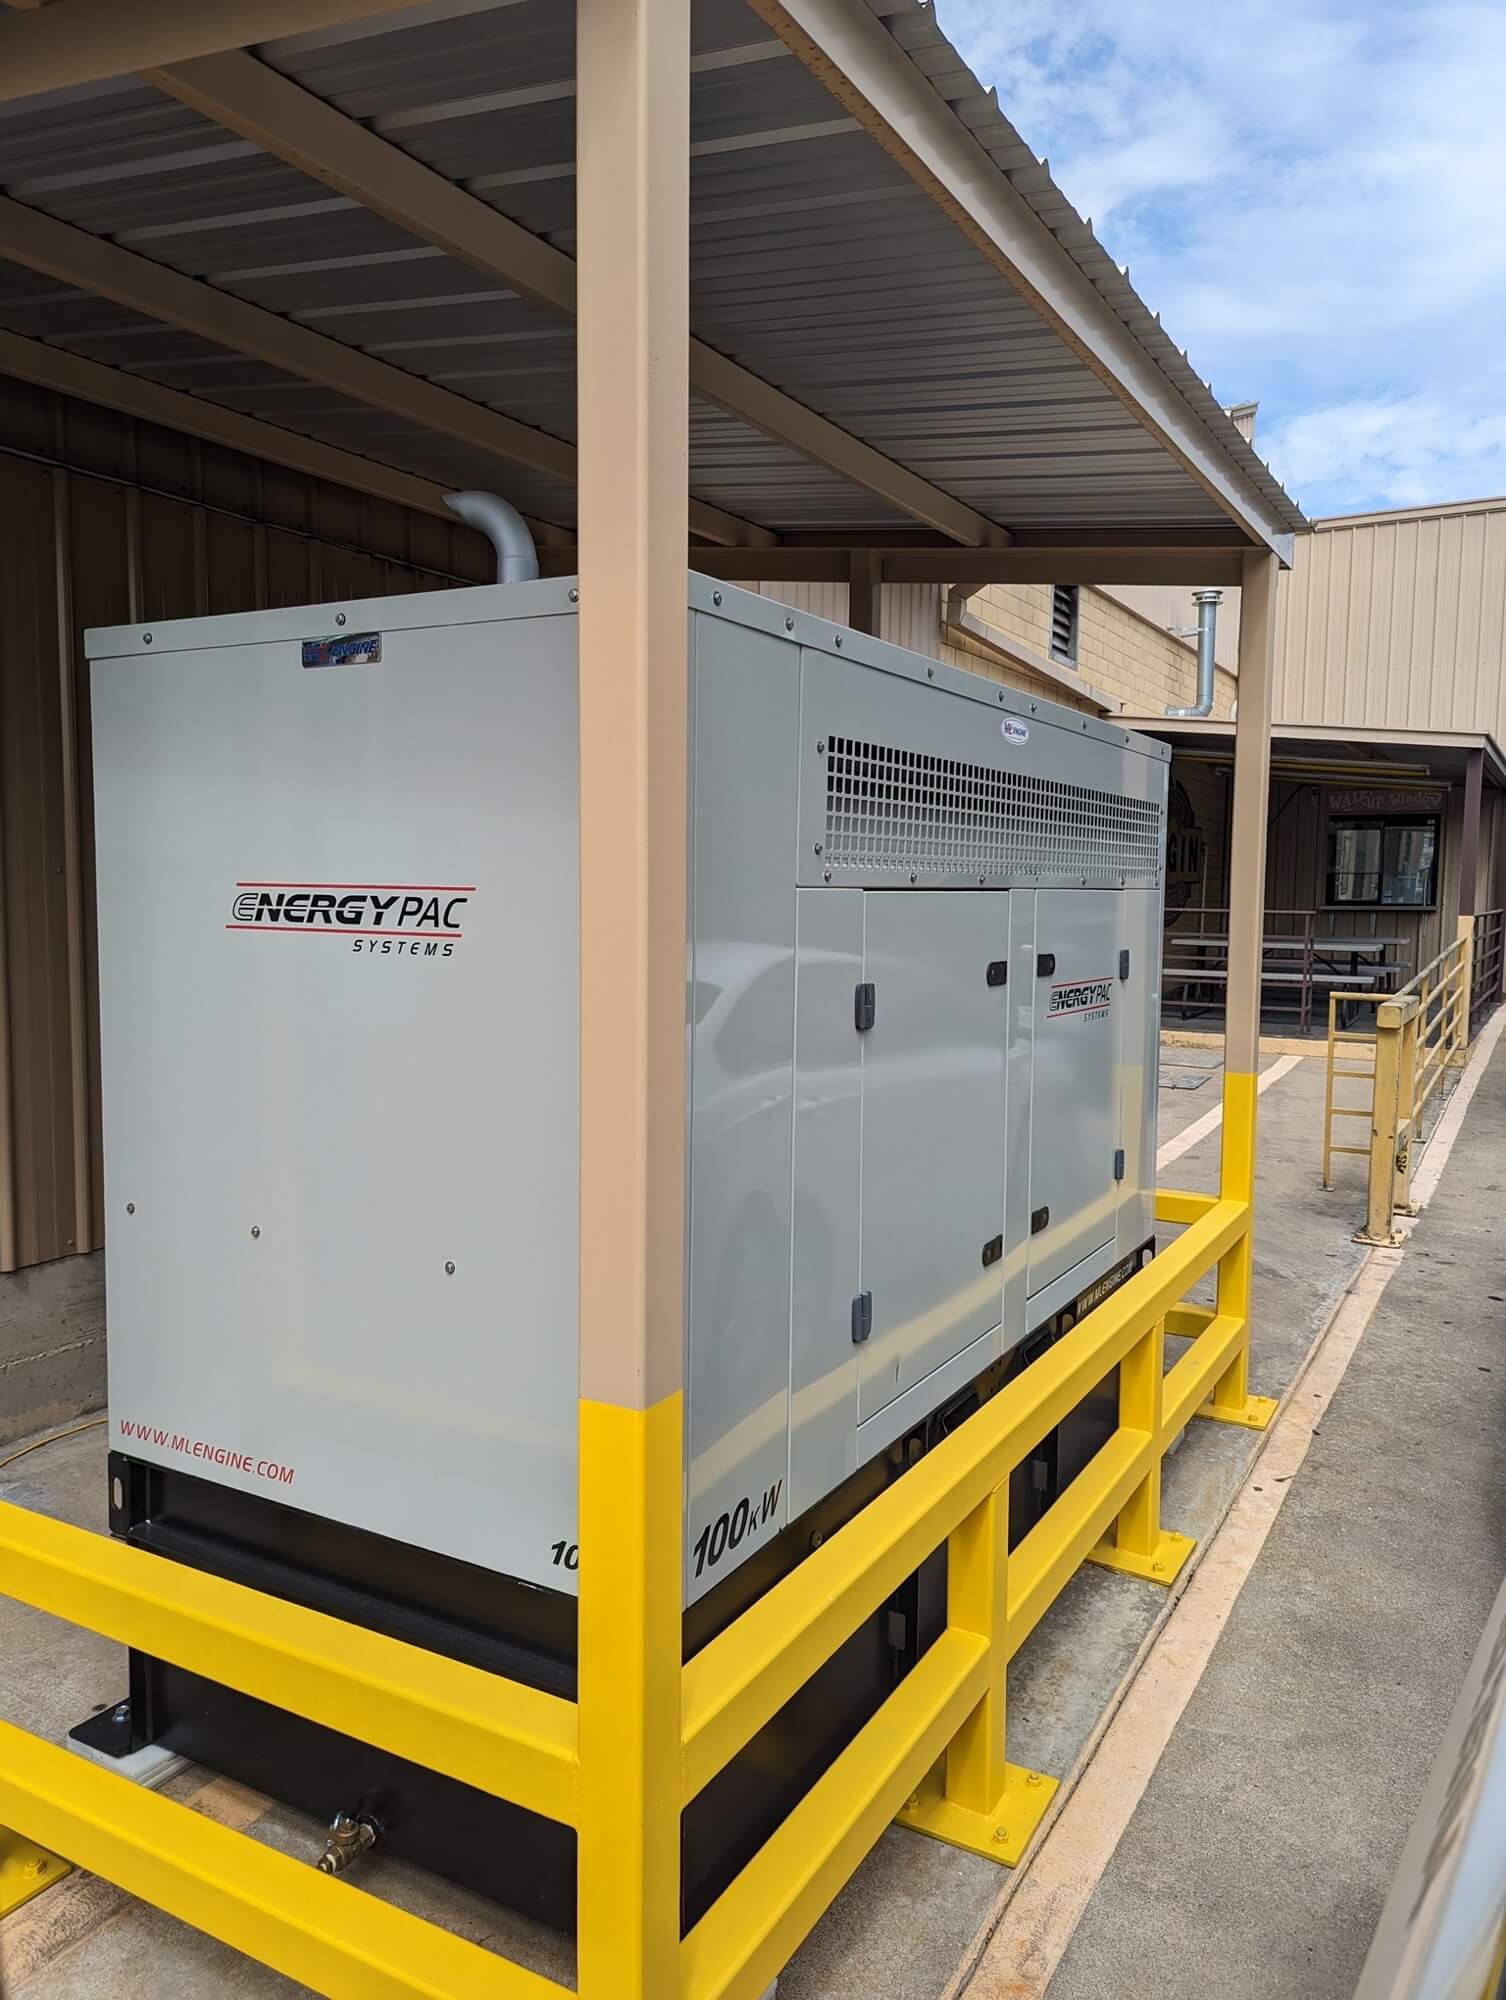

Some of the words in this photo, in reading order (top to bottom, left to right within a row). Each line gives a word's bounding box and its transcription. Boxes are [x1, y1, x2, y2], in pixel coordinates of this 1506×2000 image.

[352, 939, 454, 957] SYSTEMS
[1083, 1009, 1109, 1021] SYSTEMS
[119, 1419, 295, 1485] WWW.MLENGINE.COM
